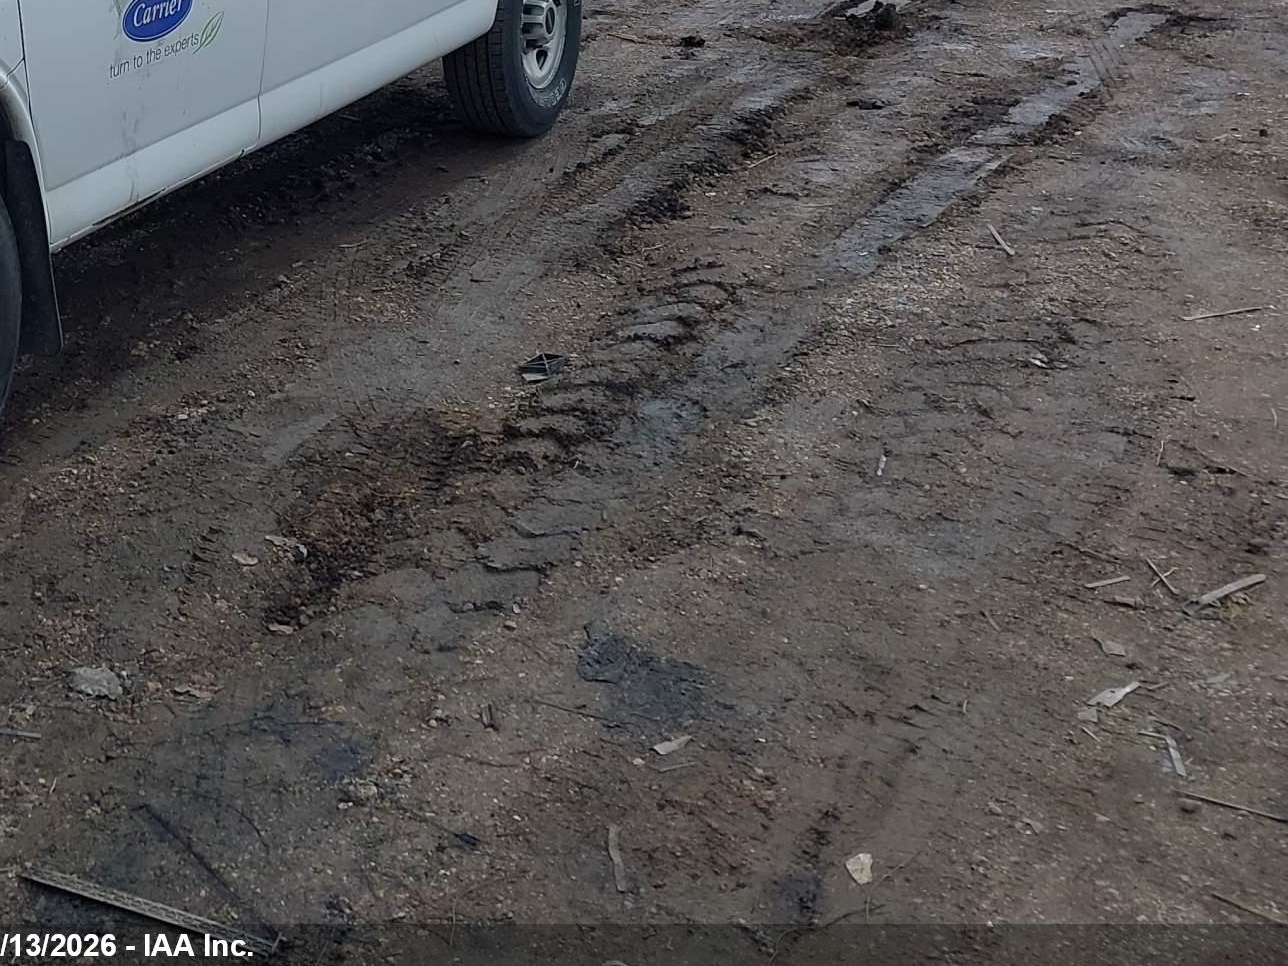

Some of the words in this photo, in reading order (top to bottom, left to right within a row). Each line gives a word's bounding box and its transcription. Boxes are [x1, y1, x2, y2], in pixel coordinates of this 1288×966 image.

[110, 59, 130, 78] turn
[133, 54, 143, 69] to
[146, 48, 162, 64] the
[164, 32, 200, 57] experts
